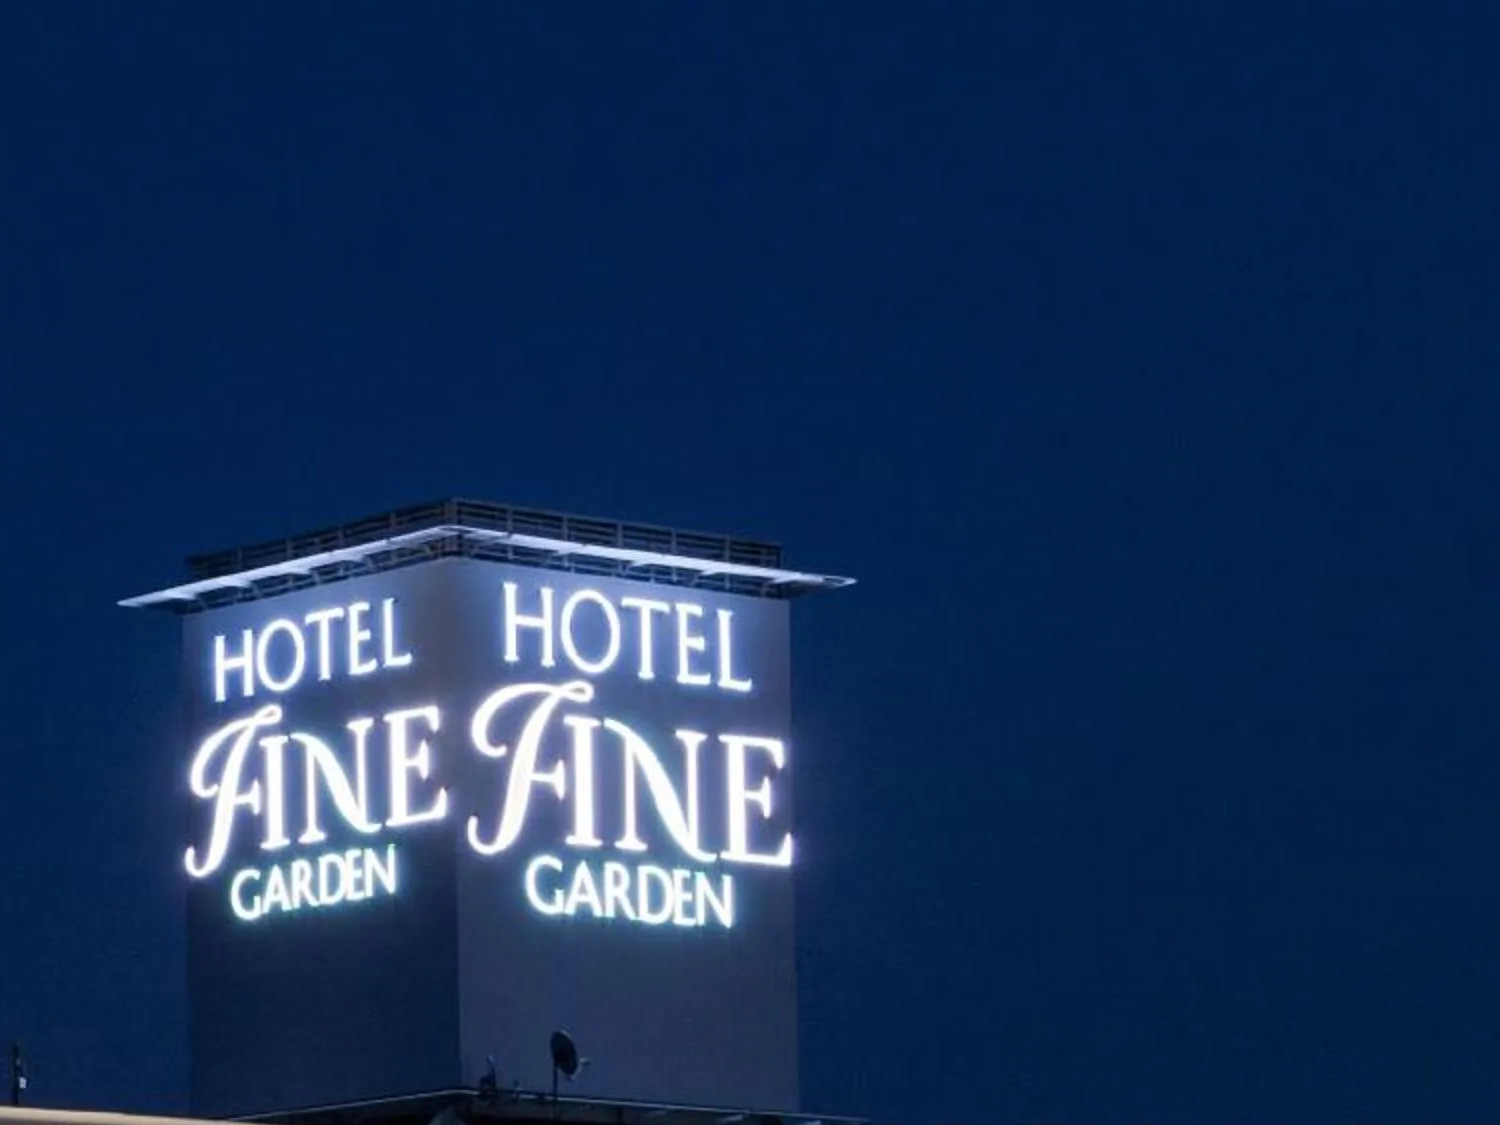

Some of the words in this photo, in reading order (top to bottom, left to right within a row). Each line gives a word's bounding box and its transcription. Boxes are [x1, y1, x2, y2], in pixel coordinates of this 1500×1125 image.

[214, 597, 412, 702] HOTEL
[503, 582, 752, 692] HOTEL
[185, 705, 447, 877] FINE
[467, 681, 793, 867] FINE
[230, 844, 397, 921] GARDEN
[525, 856, 735, 928] GARDEN
